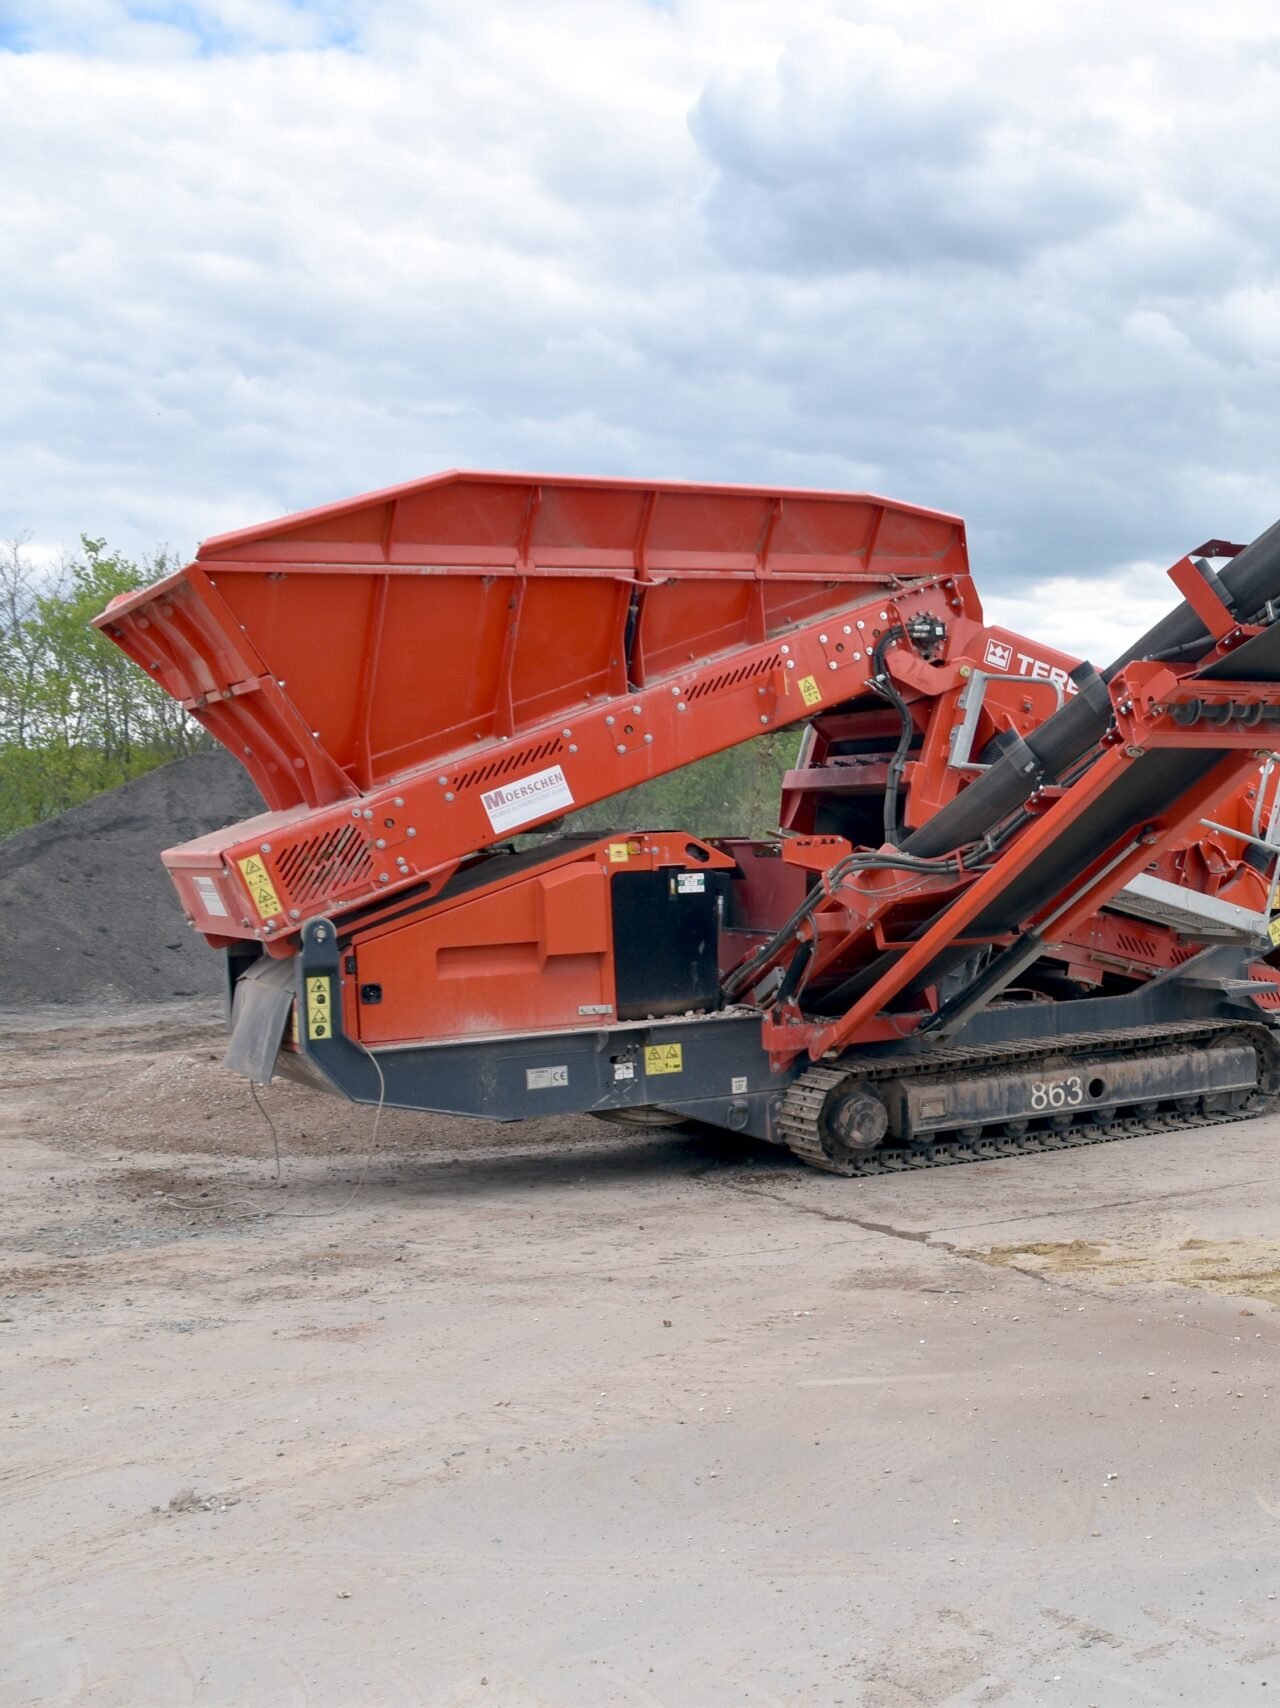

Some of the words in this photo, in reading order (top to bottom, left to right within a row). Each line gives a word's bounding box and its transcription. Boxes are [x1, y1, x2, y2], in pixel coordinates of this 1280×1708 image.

[1017, 653, 1080, 695] TERE
[483, 772, 563, 809] MOERSCHEN
[1031, 1077, 1083, 1109] 863
